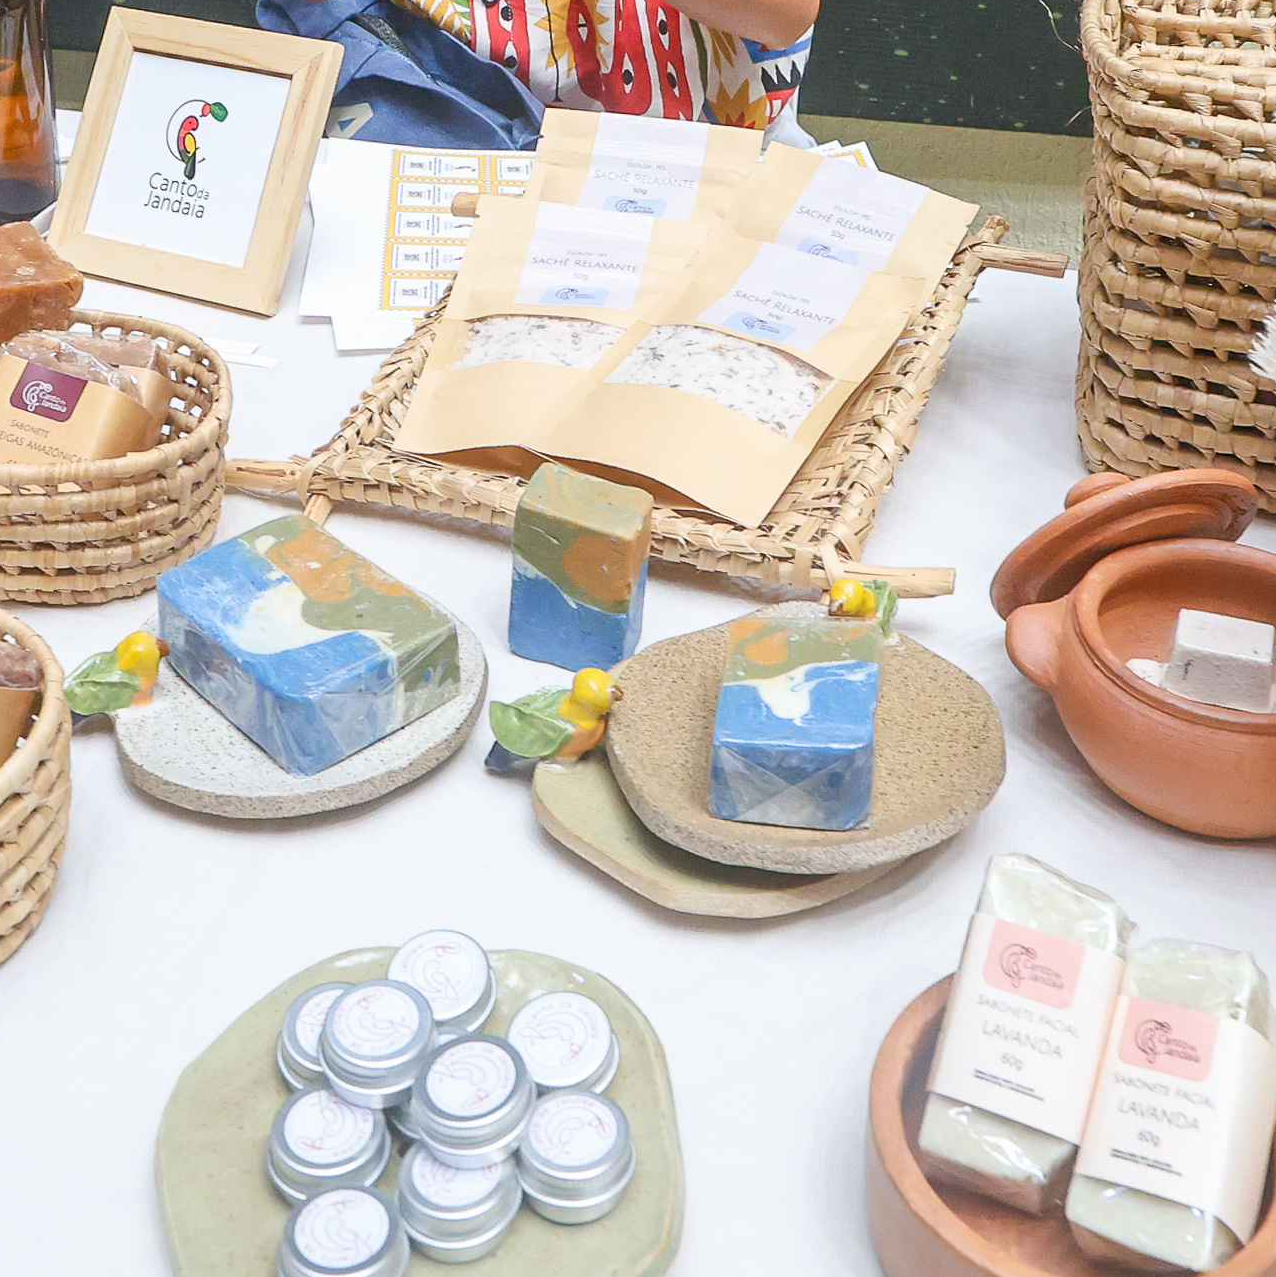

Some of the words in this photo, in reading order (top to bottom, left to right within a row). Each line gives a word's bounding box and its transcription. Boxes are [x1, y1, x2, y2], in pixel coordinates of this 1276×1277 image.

[149, 172, 197, 198] Canto
[634, 173, 695, 189] RELAXANTE
[144, 190, 206, 219] Jandaia
[835, 217, 896, 242] RELAXANTE
[573, 258, 638, 273] RELAXANTE
[773, 301, 837, 326] RELAXANTE
[9, 419, 50, 439] SABONETE
[25, 440, 90, 464] AMAZÔNICA
[977, 993, 1034, 1023] SABONETE
[981, 1019, 1063, 1060] LAVANDA
[1113, 1072, 1171, 1096] SABONETE
[1117, 1096, 1201, 1134] LAVANDA
